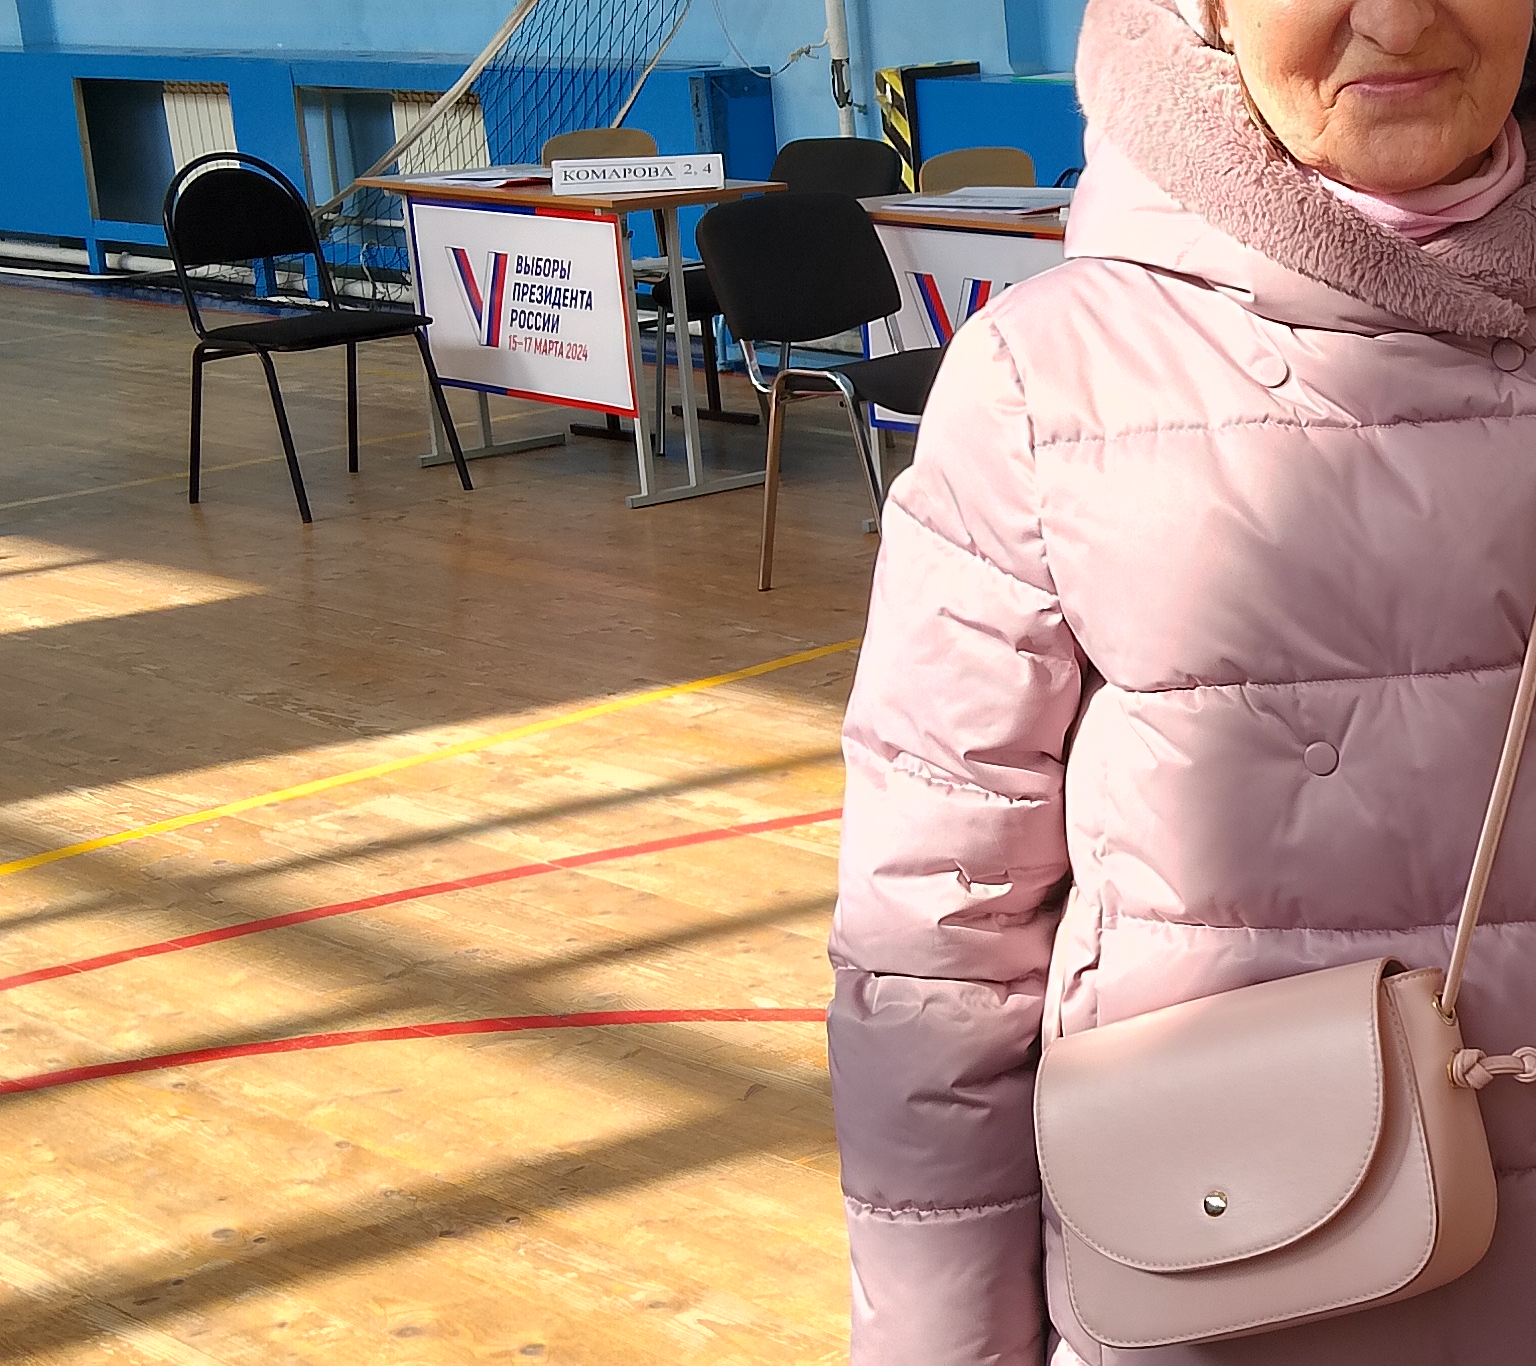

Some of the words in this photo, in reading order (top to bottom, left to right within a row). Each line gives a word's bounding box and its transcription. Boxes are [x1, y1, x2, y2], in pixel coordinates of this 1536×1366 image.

[562, 165, 673, 182] КОМАРОВА
[702, 162, 712, 174] 4
[515, 255, 572, 280] ВЫБОРЫ
[512, 282, 593, 311] ПРЕЗИДЕНТА
[510, 308, 560, 334] РОССИИ
[533, 337, 564, 359] МАРТА
[565, 342, 588, 362] 2024
